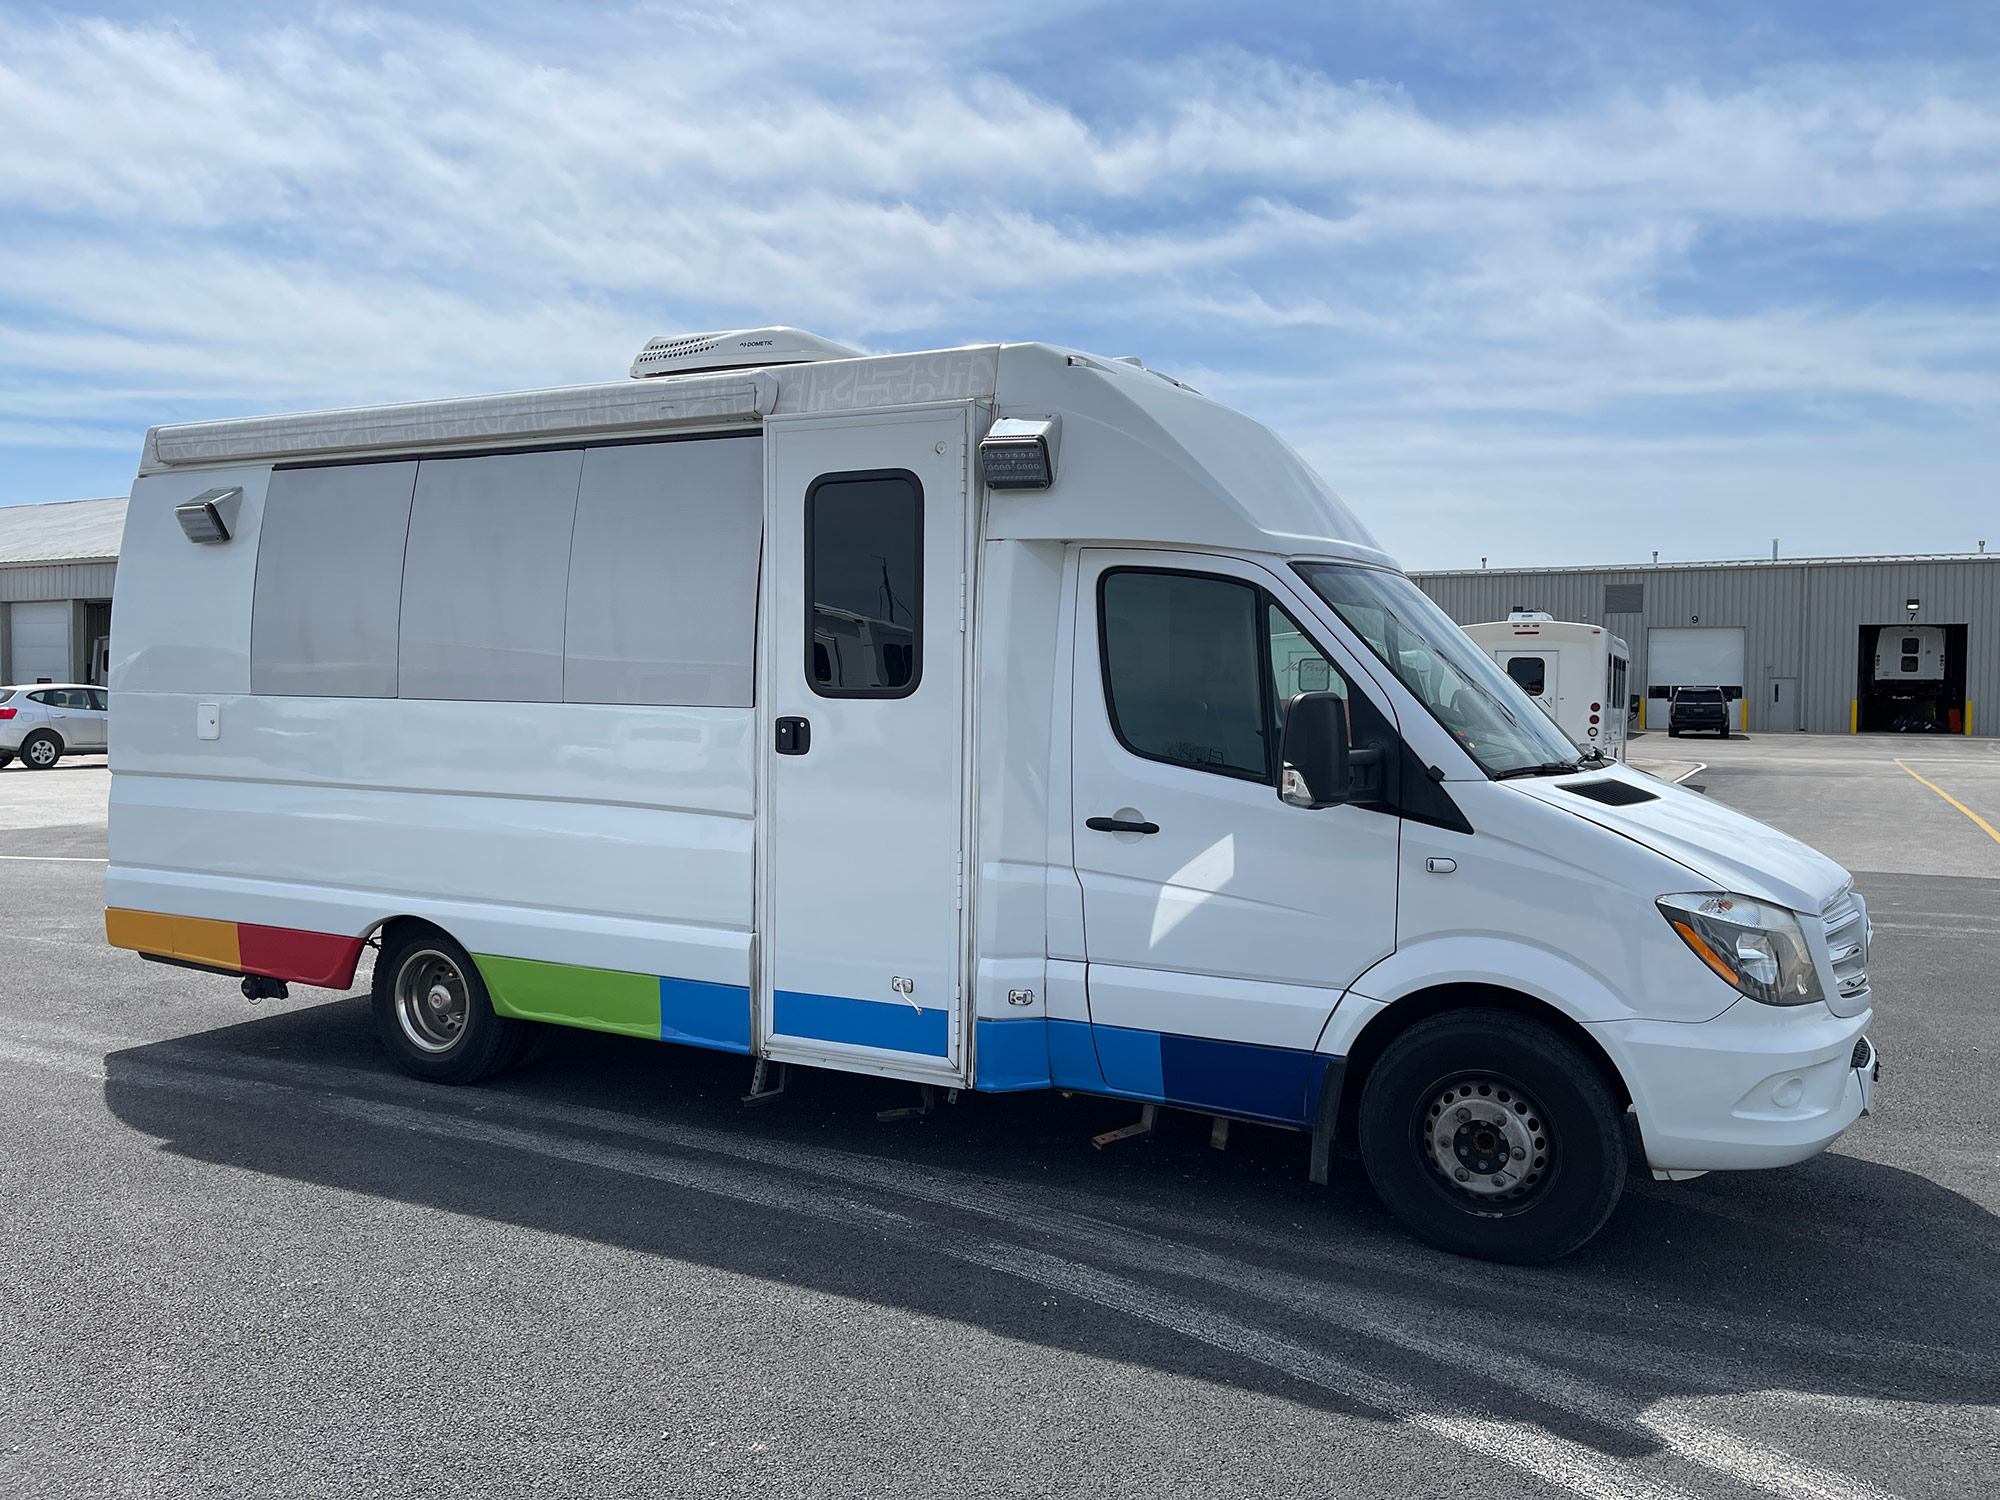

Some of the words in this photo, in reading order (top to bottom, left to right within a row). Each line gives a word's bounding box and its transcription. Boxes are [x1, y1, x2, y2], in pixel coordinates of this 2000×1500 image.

[747, 340, 773, 348] DOMETIC
[1691, 615, 1699, 624] 9
[1909, 612, 1917, 622] 7
